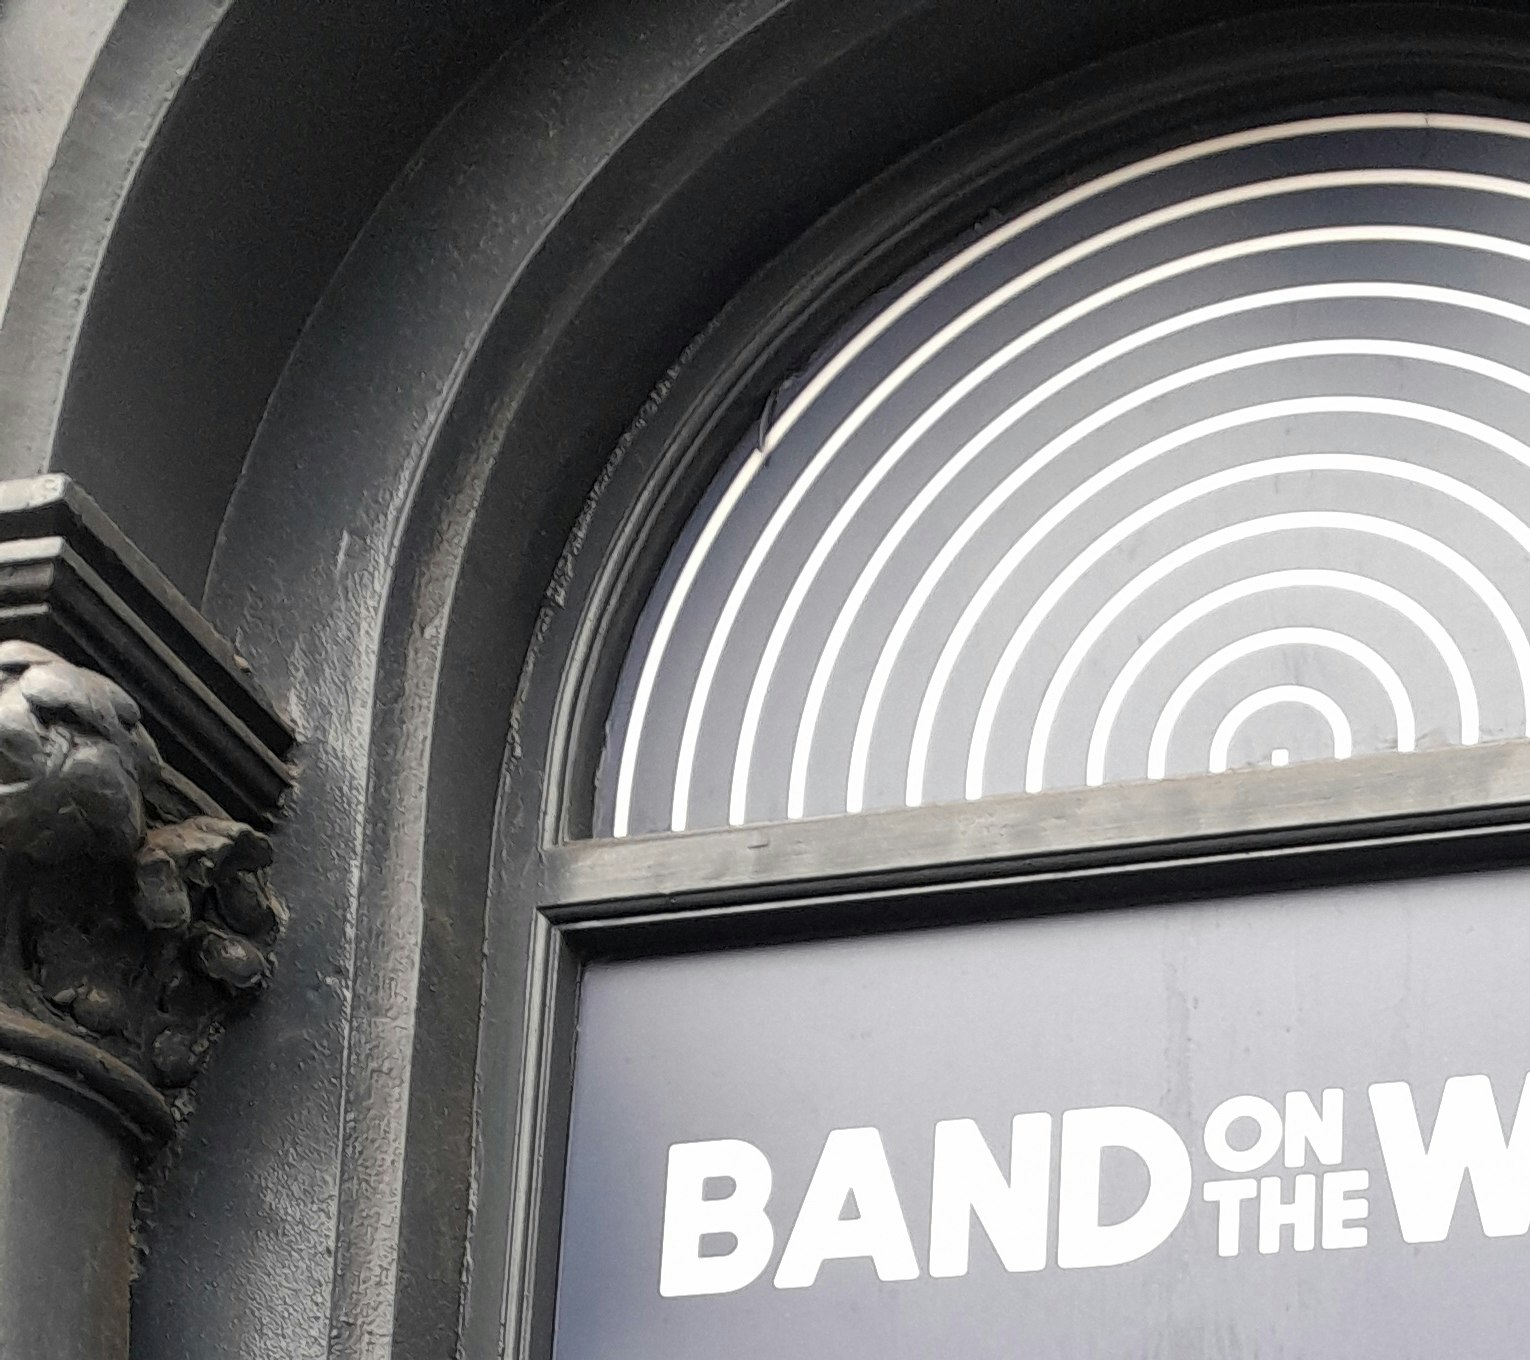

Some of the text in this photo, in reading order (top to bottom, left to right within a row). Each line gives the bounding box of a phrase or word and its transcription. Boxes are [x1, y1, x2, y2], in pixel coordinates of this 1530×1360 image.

[1203, 1088, 1344, 1173] ON
[659, 1106, 1192, 1297] BAND
[1203, 1169, 1369, 1257] THE
